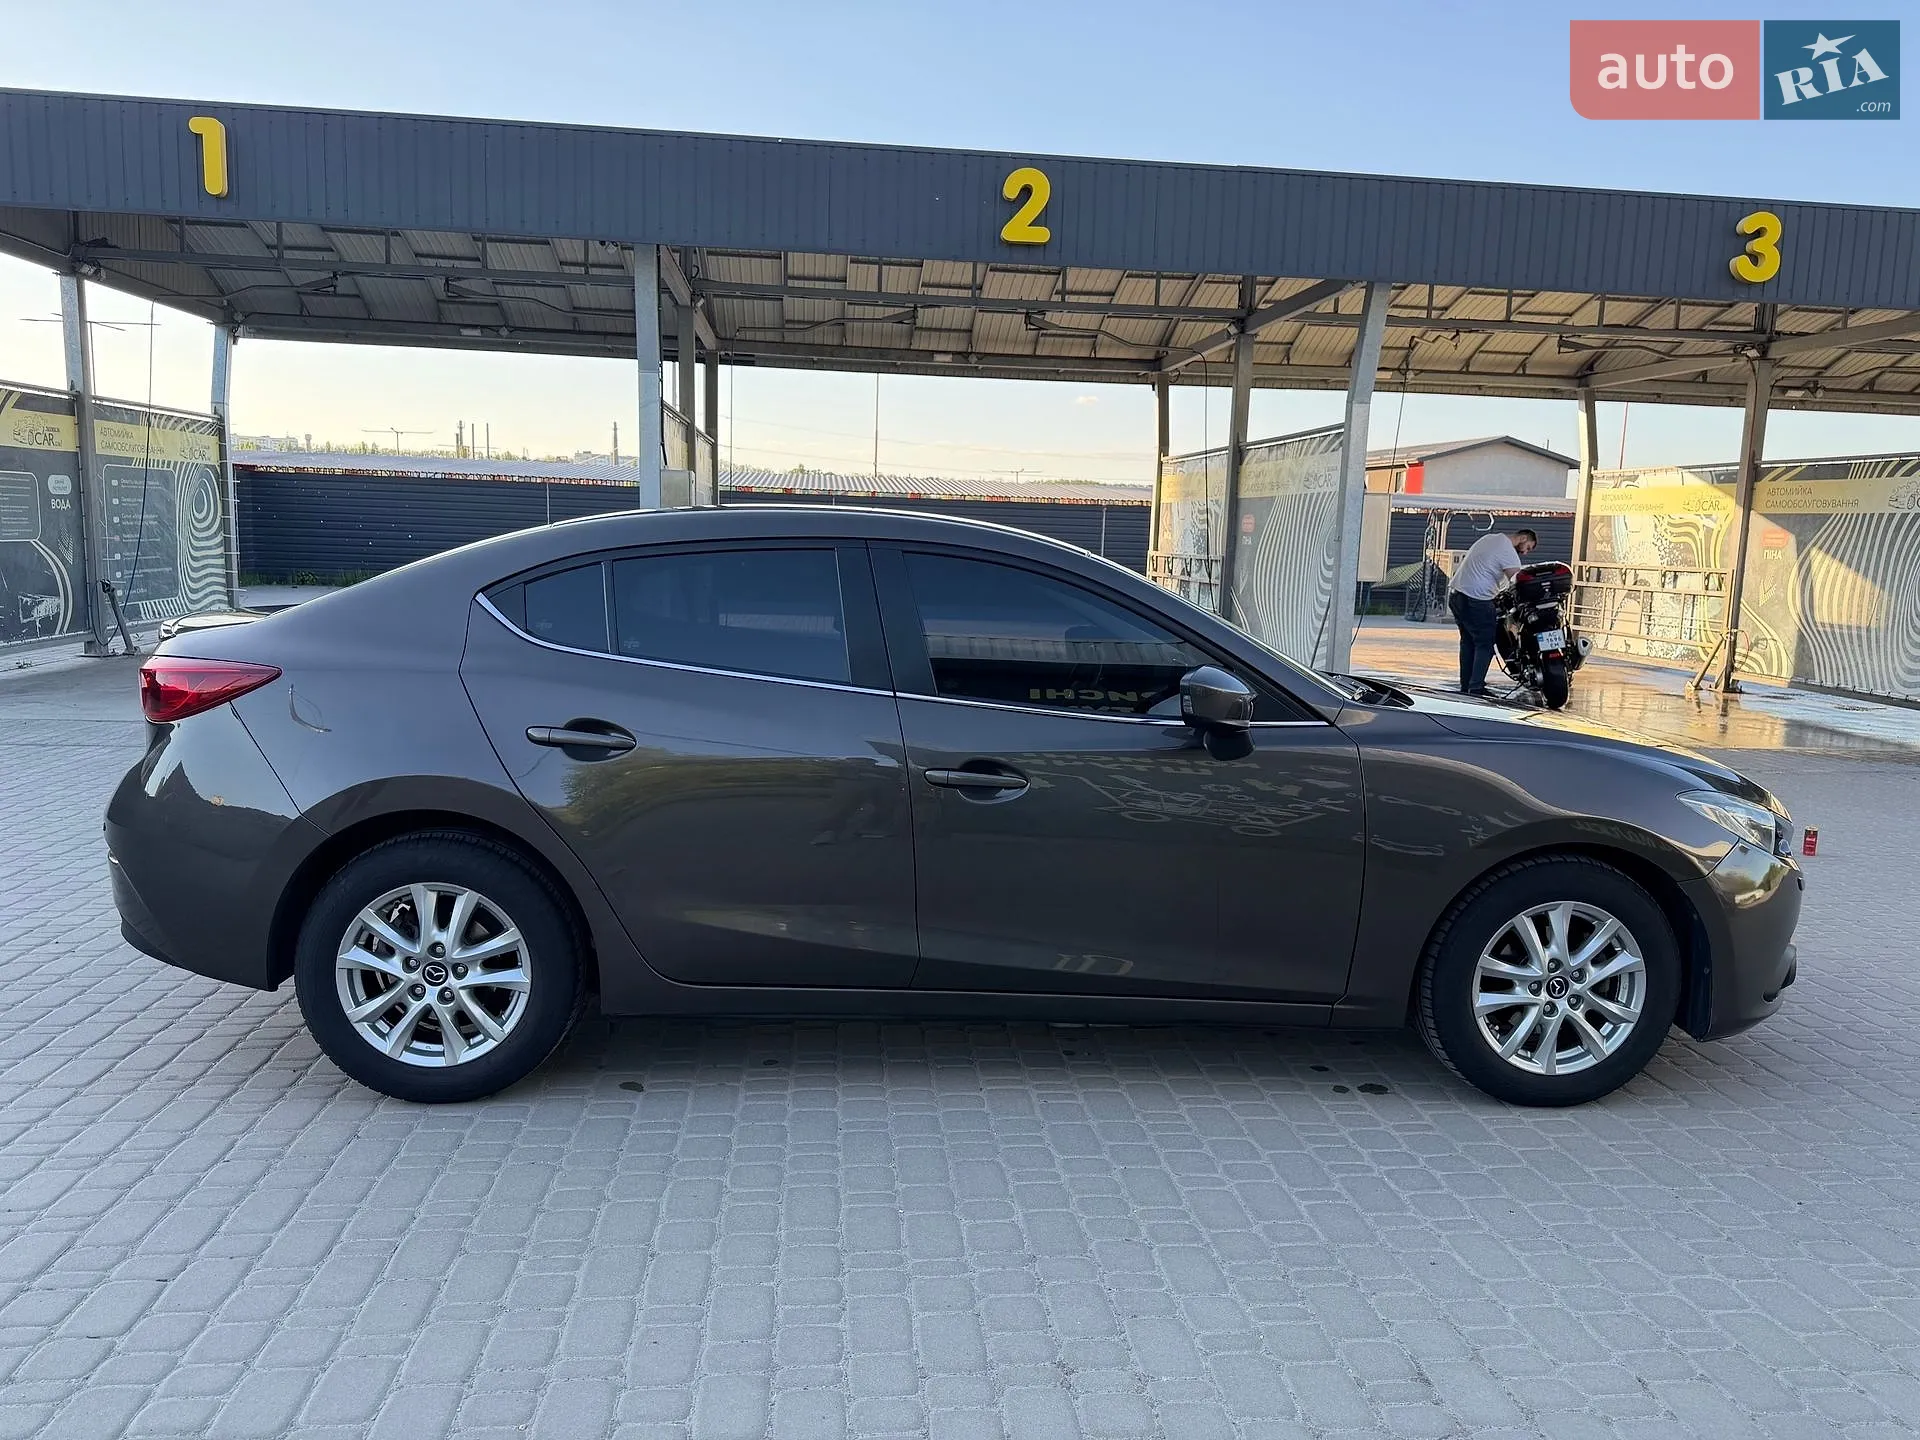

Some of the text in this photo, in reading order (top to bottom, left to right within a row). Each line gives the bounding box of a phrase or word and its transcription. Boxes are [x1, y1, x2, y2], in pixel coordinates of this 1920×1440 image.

[188, 116, 228, 198] 1
[1001, 167, 1051, 245] 2
[1729, 211, 1782, 284] 3
[1766, 485, 1813, 497] АВТОМИЙКА
[51, 498, 71, 511] ВОДА
[1765, 498, 1859, 509] САМООБСЛУГОВУВАННЯ
[1764, 549, 1783, 561] ПІНА
